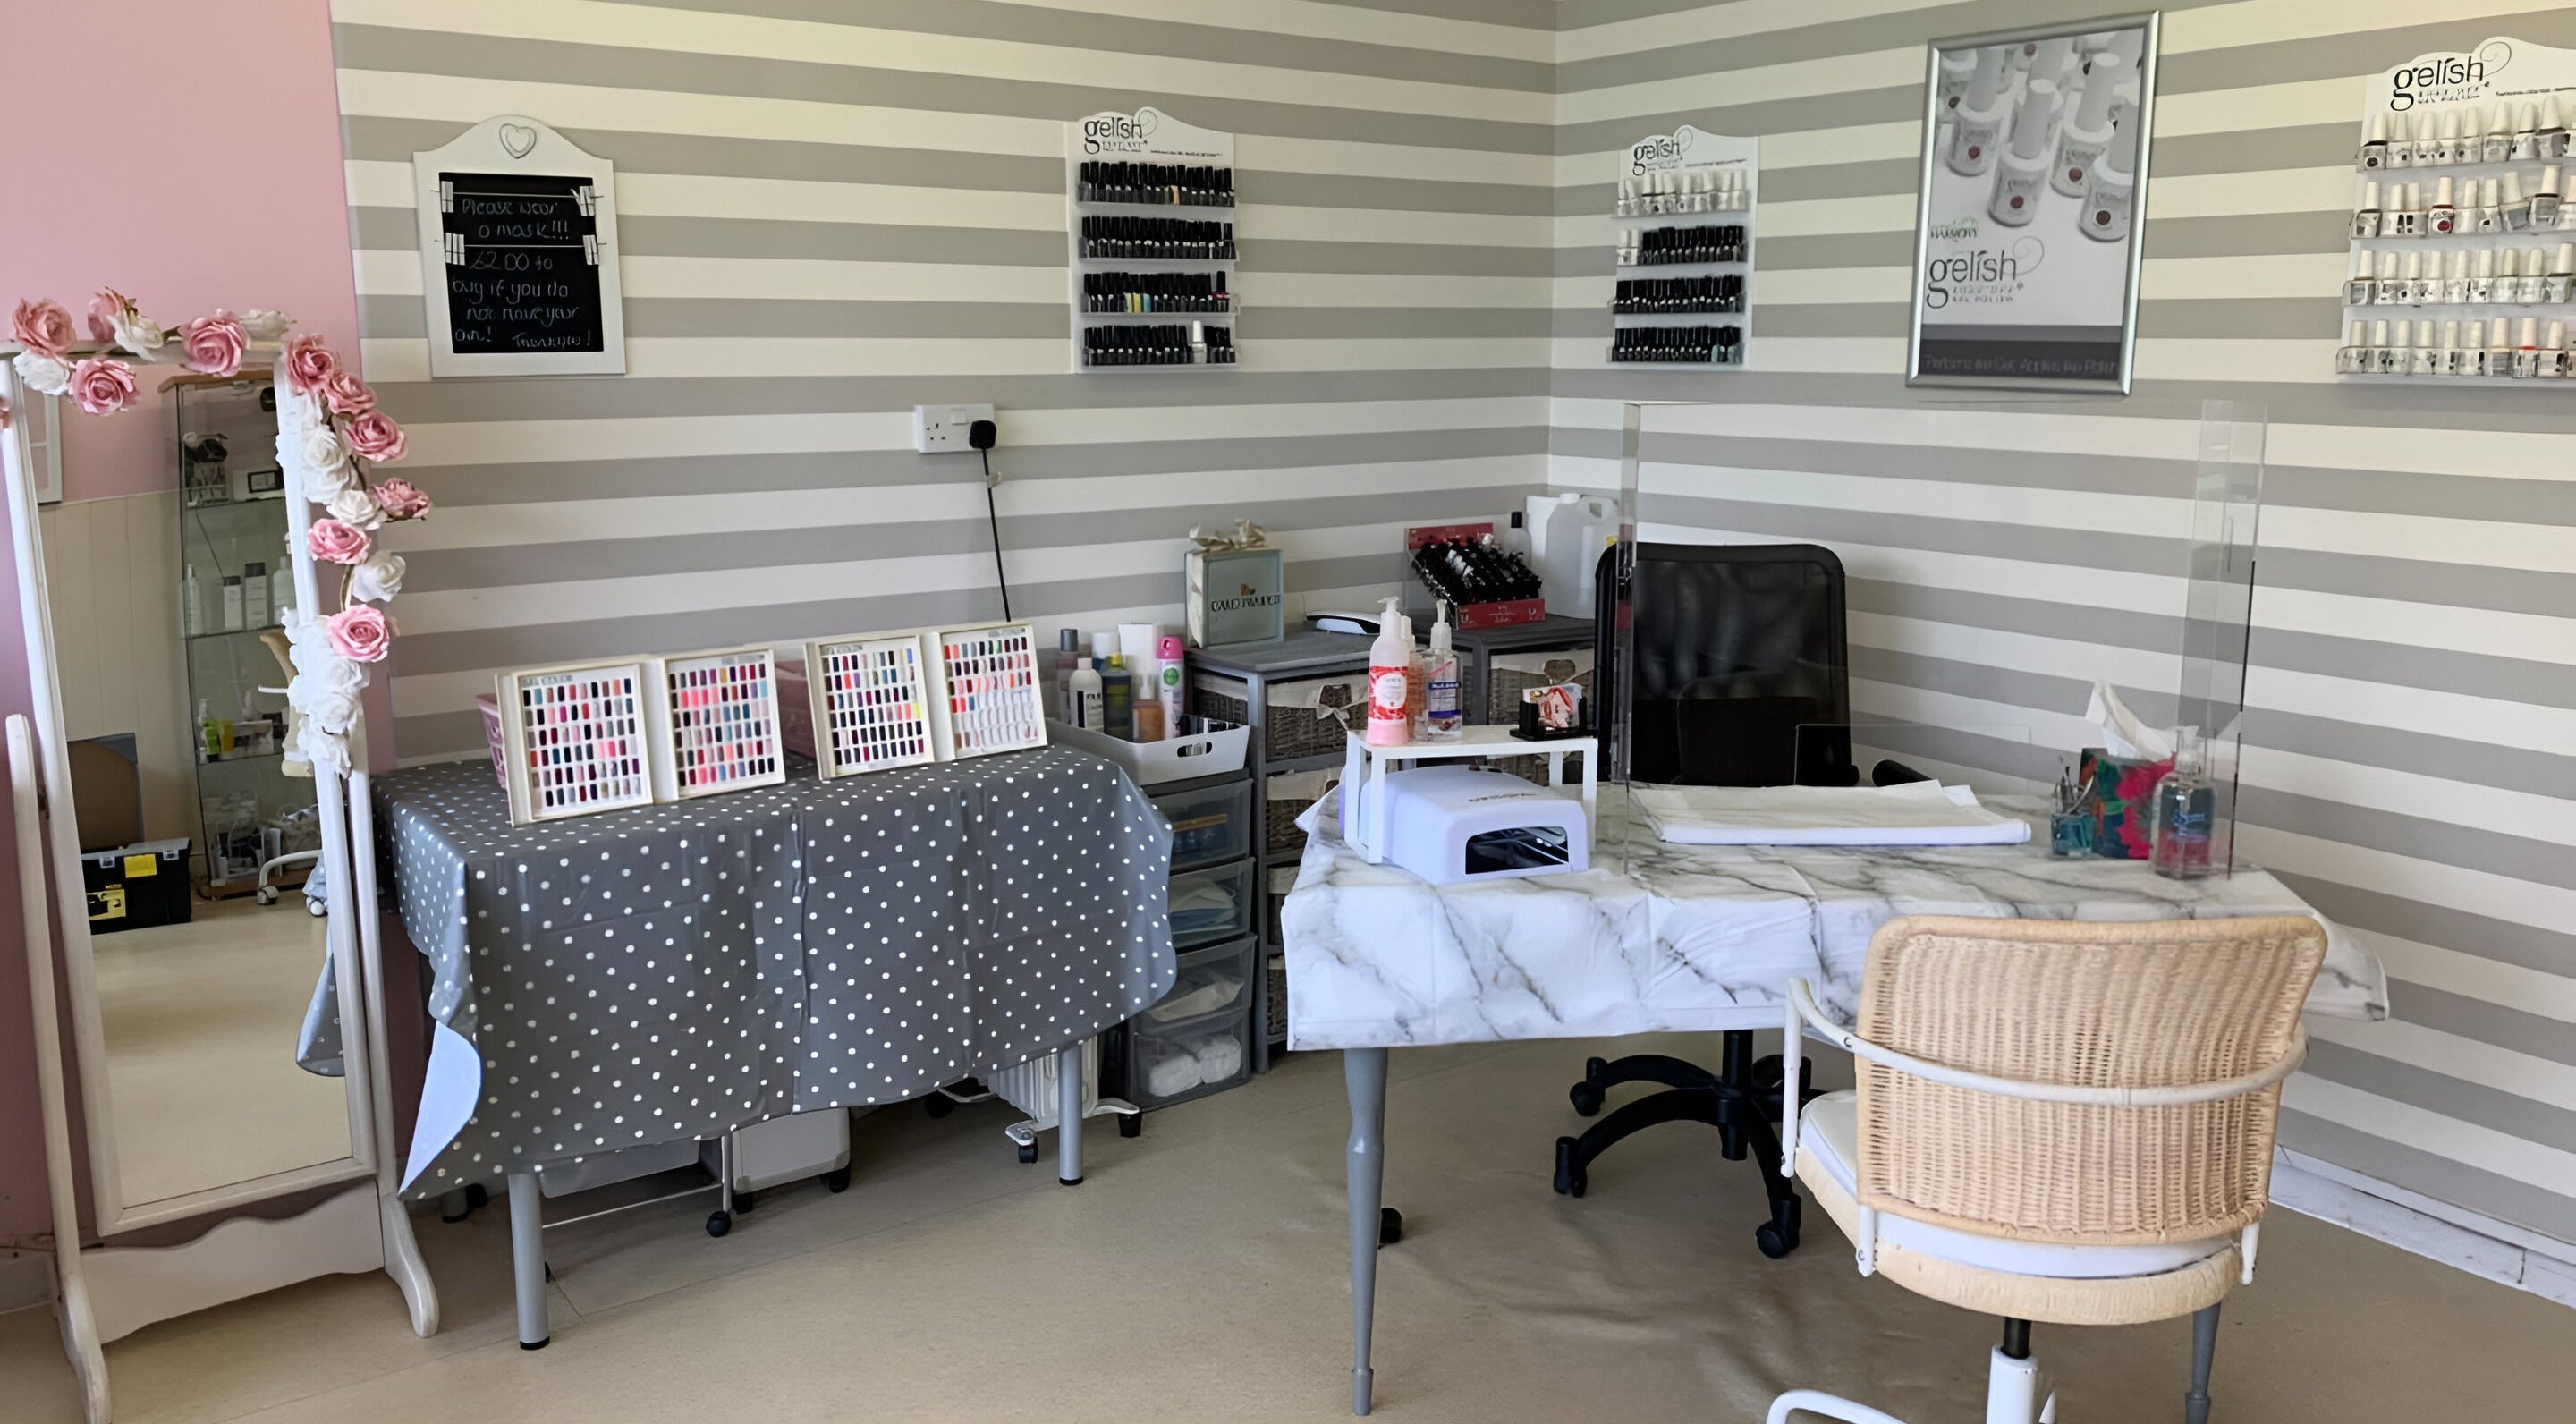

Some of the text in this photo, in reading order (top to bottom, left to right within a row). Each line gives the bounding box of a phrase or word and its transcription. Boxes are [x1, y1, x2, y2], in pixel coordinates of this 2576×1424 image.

[2390, 55, 2484, 112] gelish
[1084, 116, 1143, 155] gelish
[1632, 138, 1681, 176] gelish
[463, 199, 557, 215] Please wear
[453, 278, 567, 304] buy if you do
[1926, 250, 2017, 309] gelish
[467, 306, 578, 326] not have your
